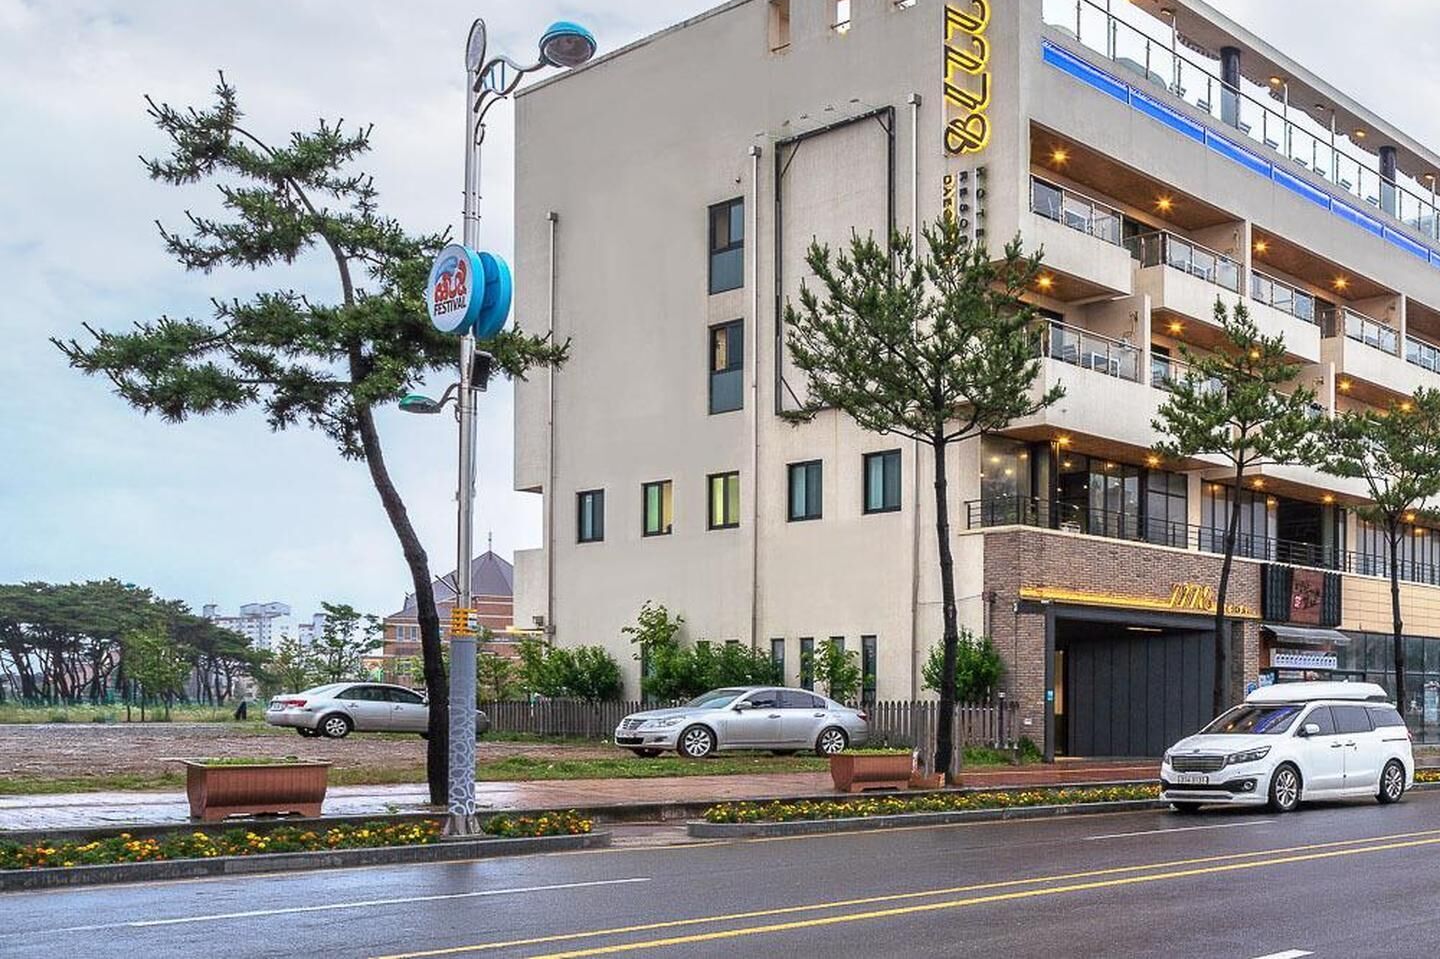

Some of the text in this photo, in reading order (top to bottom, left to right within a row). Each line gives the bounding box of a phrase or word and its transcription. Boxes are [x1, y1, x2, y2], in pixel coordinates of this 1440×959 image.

[959, 171, 969, 244] RESOR
[976, 167, 986, 239] HOTE
[433, 296, 467, 316] FESTIVAL
